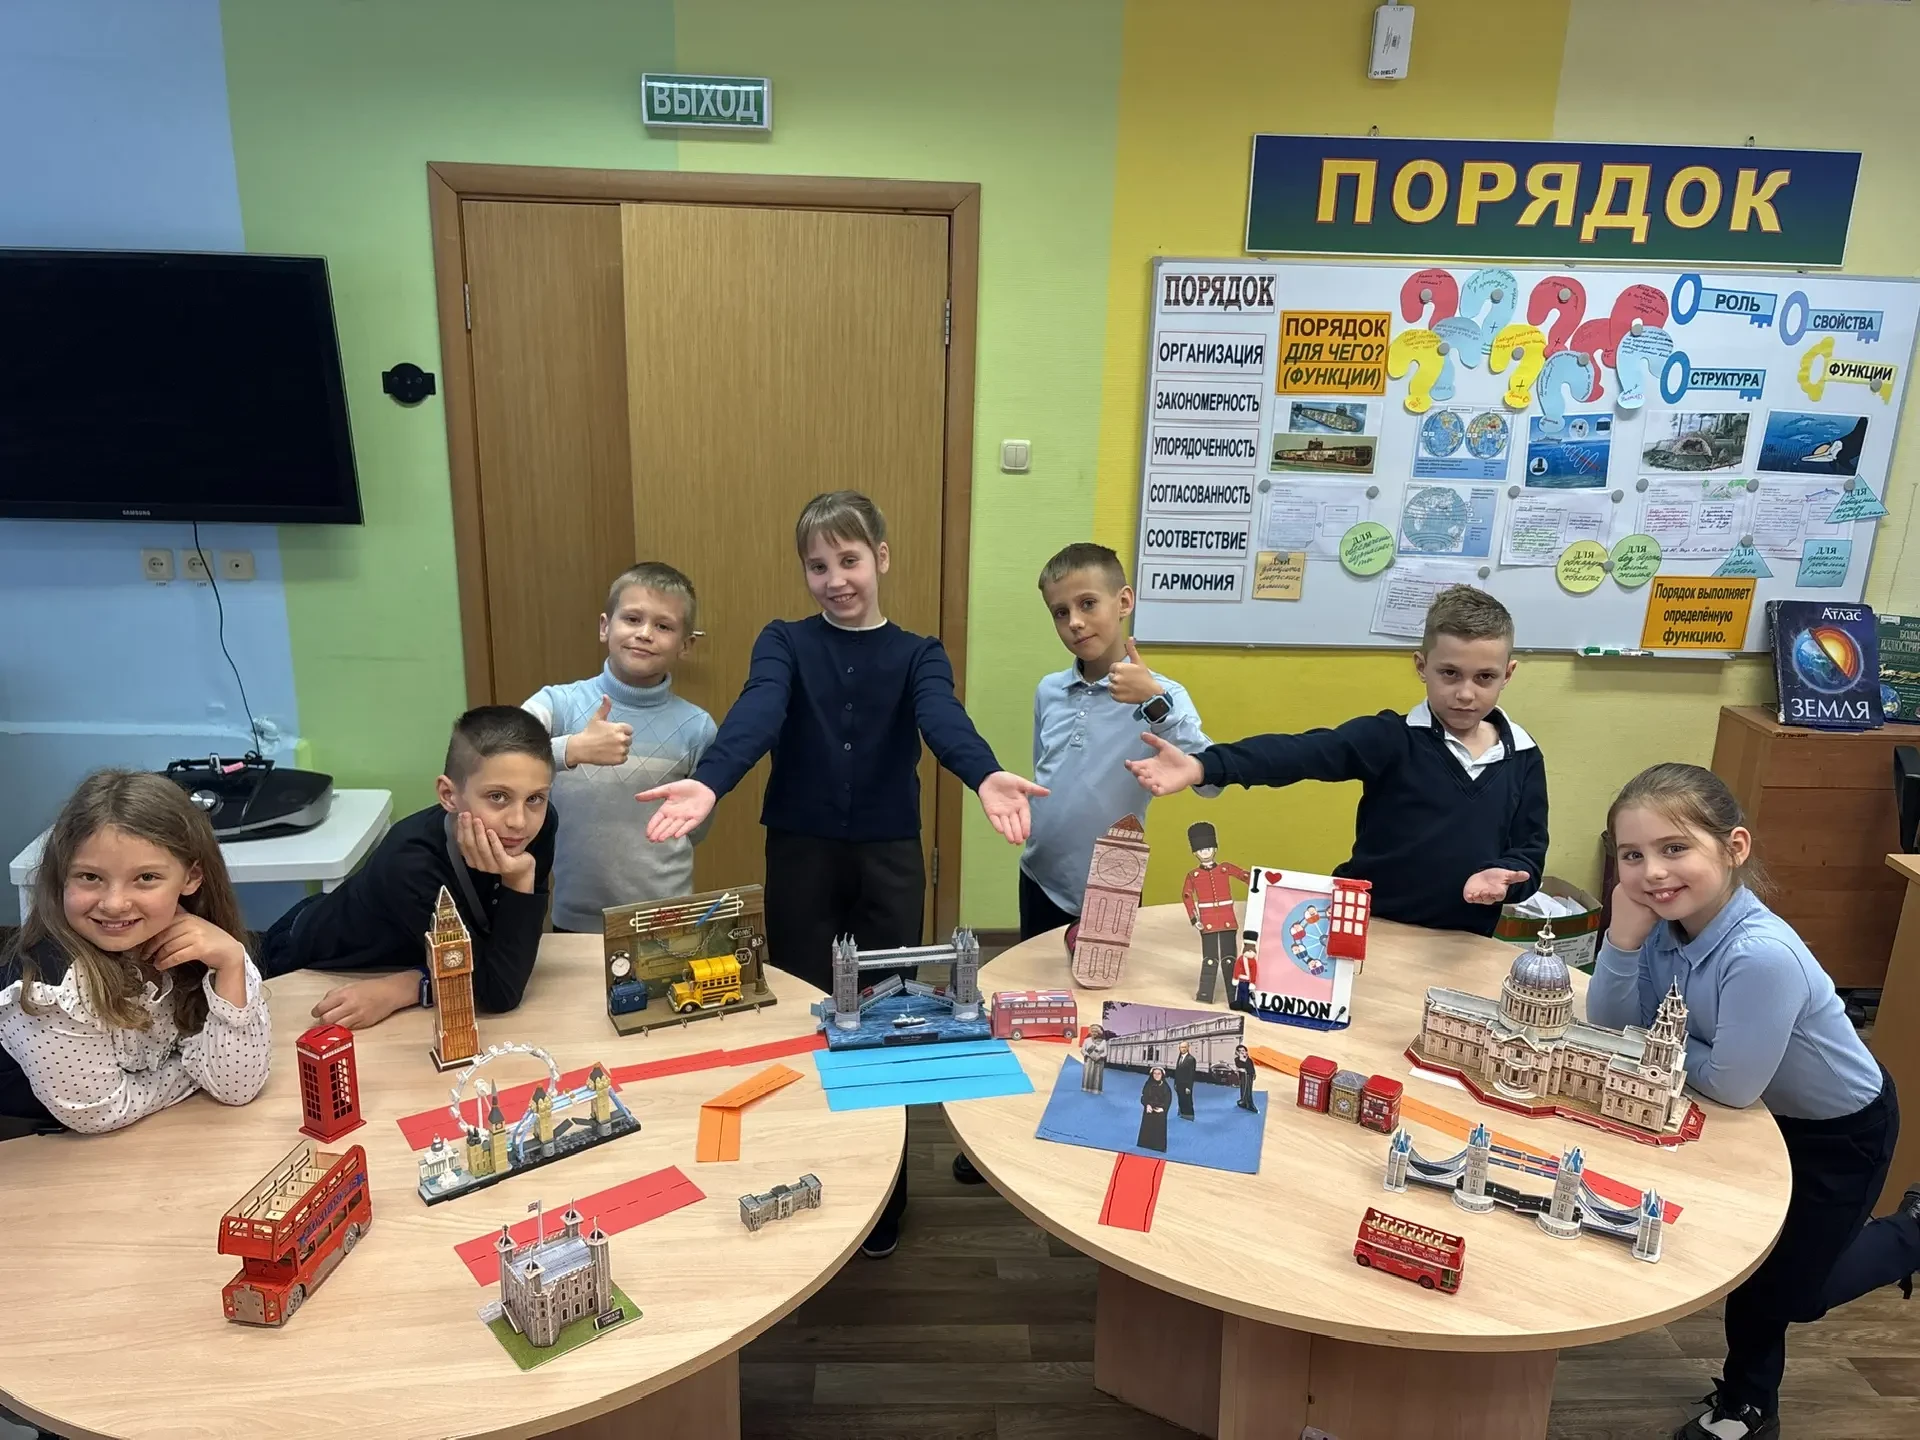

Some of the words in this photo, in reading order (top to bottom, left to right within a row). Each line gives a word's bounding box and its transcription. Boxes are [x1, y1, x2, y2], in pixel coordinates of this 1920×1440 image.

[653, 82, 758, 122] ВЫХОД
[1315, 157, 1792, 244] ПОРЯДОК
[1164, 275, 1275, 311] ПОРЯДОК
[1715, 294, 1761, 312] РОЛЬ
[1286, 318, 1387, 340] ПОРЯДОК
[1813, 313, 1874, 330] СВОЙСТВА
[1159, 343, 1263, 367] ОРГАНИЗАЦИЯ
[1284, 343, 1324, 364] ДЛЯ
[1329, 344, 1385, 361] ЧЕГО?
[1283, 367, 1381, 389] (ФУНКЦИИ)
[1691, 371, 1760, 388] СТРУКТУРА
[1829, 362, 1893, 382] ФУНКЦИИ
[1157, 392, 1259, 413] ЗАКОНОМЕРНОСТЬ
[1154, 436, 1256, 460] УПОРЯДОЧЕННОСТЬ
[1150, 484, 1250, 505] СОГЛАСОВАННОСТЬ
[1147, 529, 1247, 550] СООТВЕТСТВИЕ
[1352, 531, 1373, 545] ДЛЯ
[1573, 551, 1594, 559] ДЛЯ
[1627, 545, 1647, 554] ДЛЯ
[1733, 548, 1754, 558] ДЛЯ
[1815, 547, 1837, 555] ДЛЯ
[1151, 573, 1235, 591] ГАРМОНИЯ
[1654, 583, 1697, 602] Порядок
[1697, 587, 1751, 600] выполняет
[1663, 606, 1733, 626] определённую
[1663, 627, 1726, 645] функцию.
[1791, 698, 1870, 720] ЗЕМЛЯ
[1250, 868, 1262, 893] I
[733, 928, 752, 937] HOME
[751, 936, 764, 947] BUS
[1259, 992, 1332, 1019] LONDON
